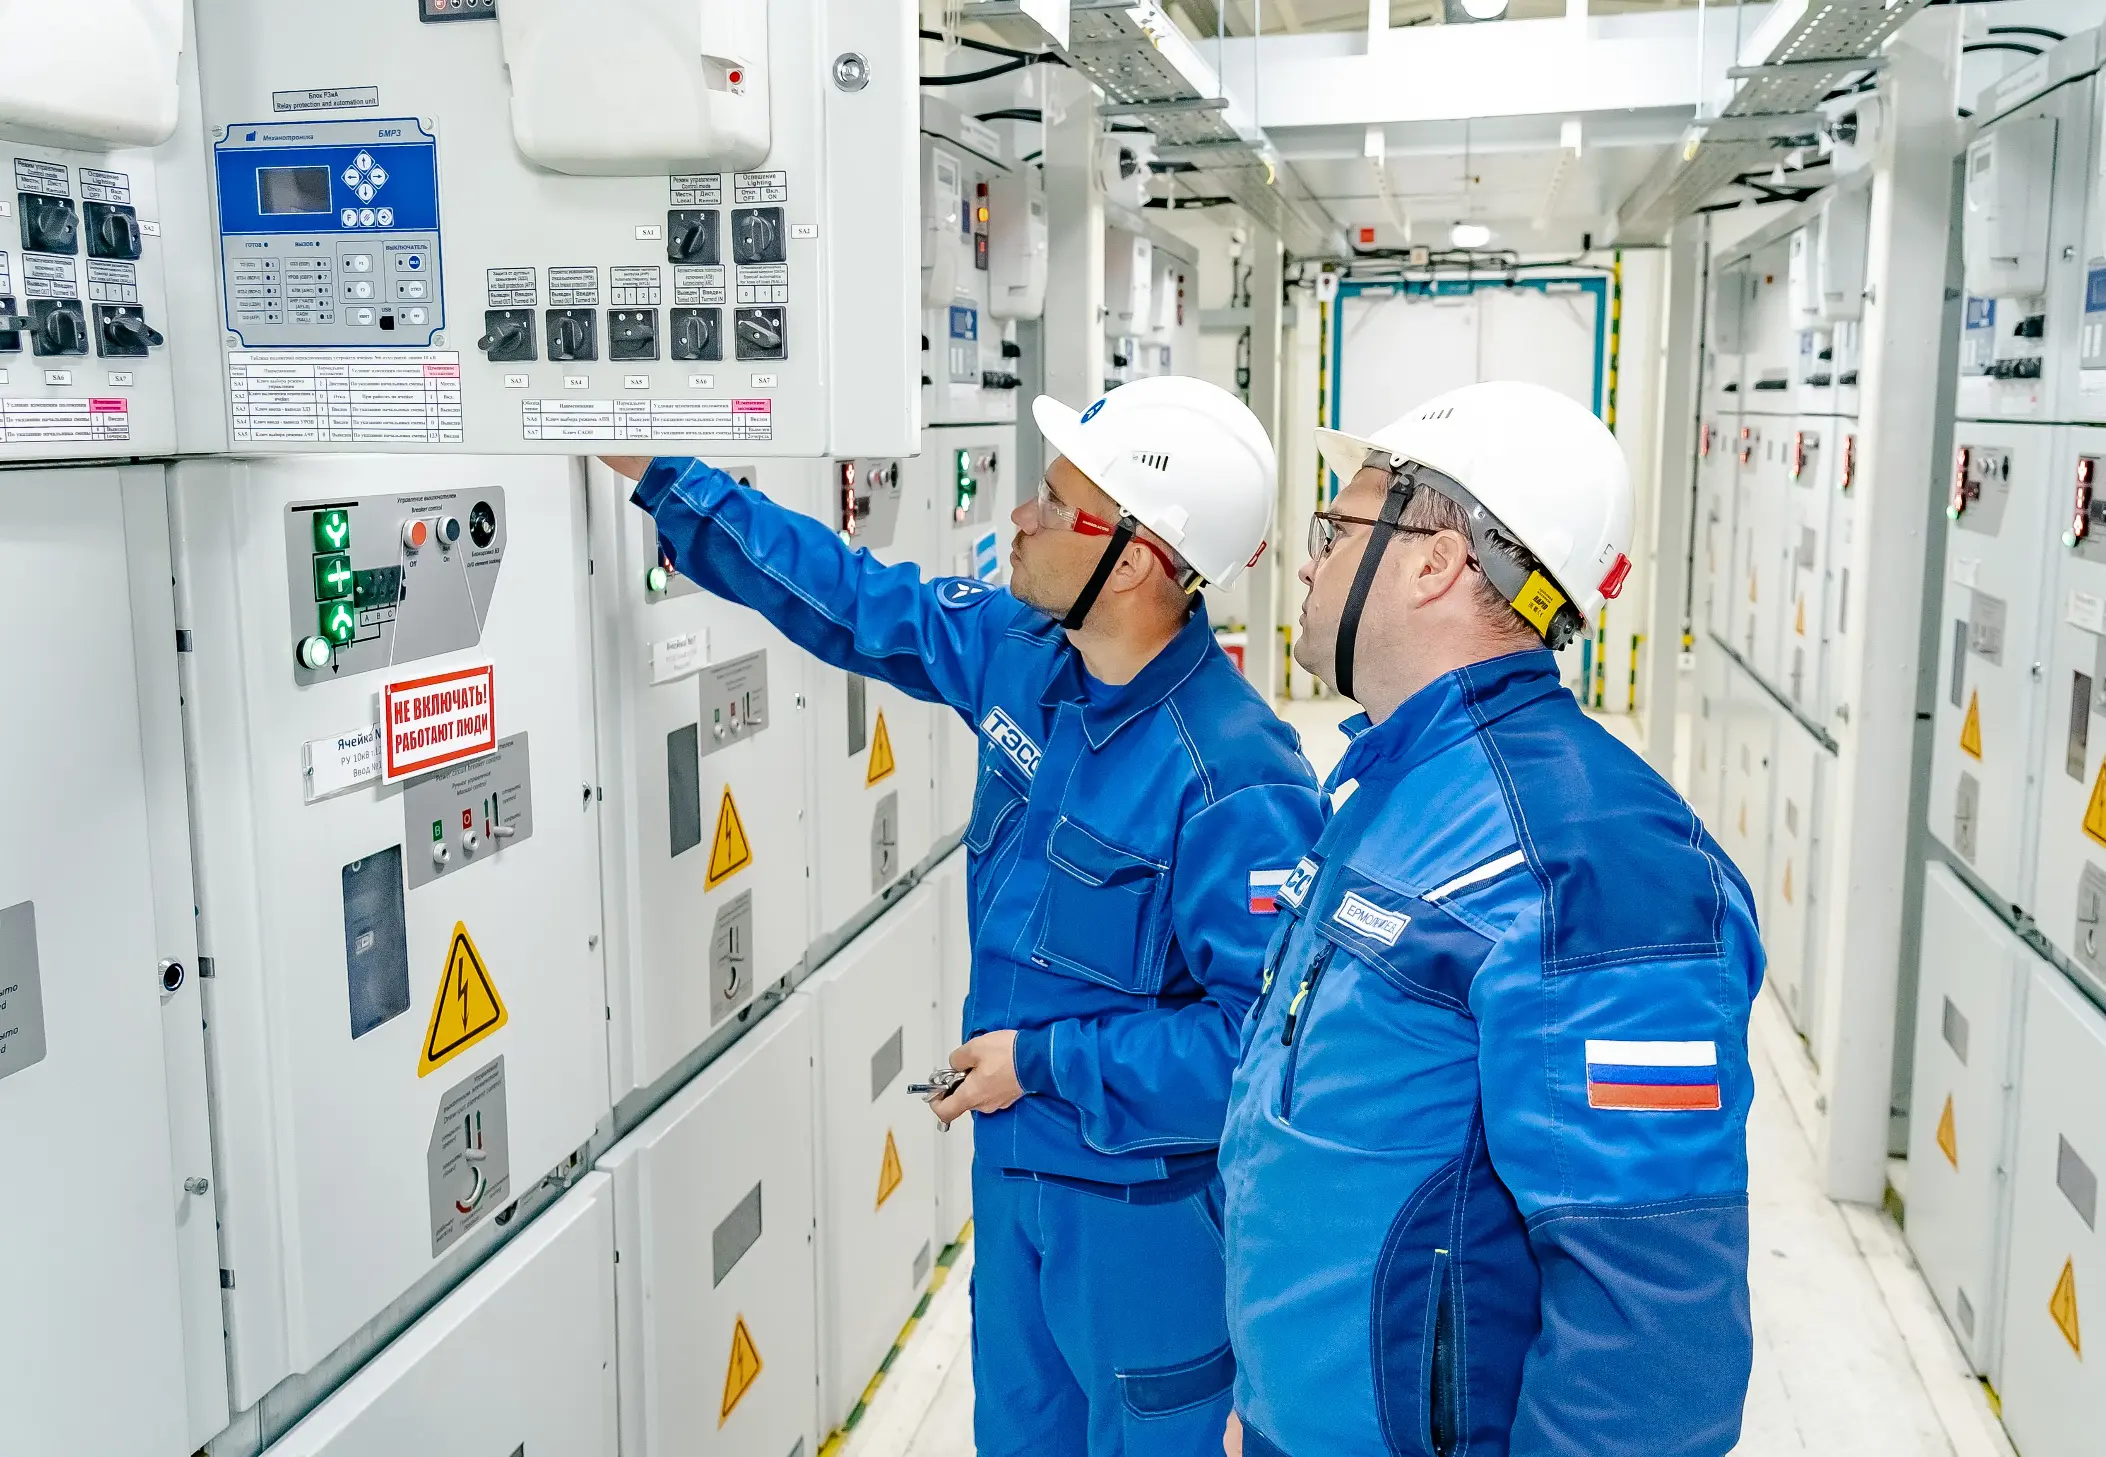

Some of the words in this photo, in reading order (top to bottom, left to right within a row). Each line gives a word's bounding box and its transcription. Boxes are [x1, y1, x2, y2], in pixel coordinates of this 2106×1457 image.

[276, 102, 292, 110] Relay
[293, 101, 321, 110] protection
[365, 97, 376, 105] unit
[378, 129, 402, 138] БМРЗ
[411, 506, 428, 514] Breaker
[428, 504, 443, 512] control
[409, 560, 417, 568] Off
[364, 614, 370, 622] A
[394, 699, 411, 725] НЕ
[413, 683, 488, 721] ВКЛЮЧАТЬ!
[395, 721, 454, 754] РАБОТАЮТ
[456, 712, 489, 738] ЛЮДИ
[338, 732, 374, 751] Ячейка
[341, 755, 351, 766] РУ
[353, 766, 371, 778] Ввод
